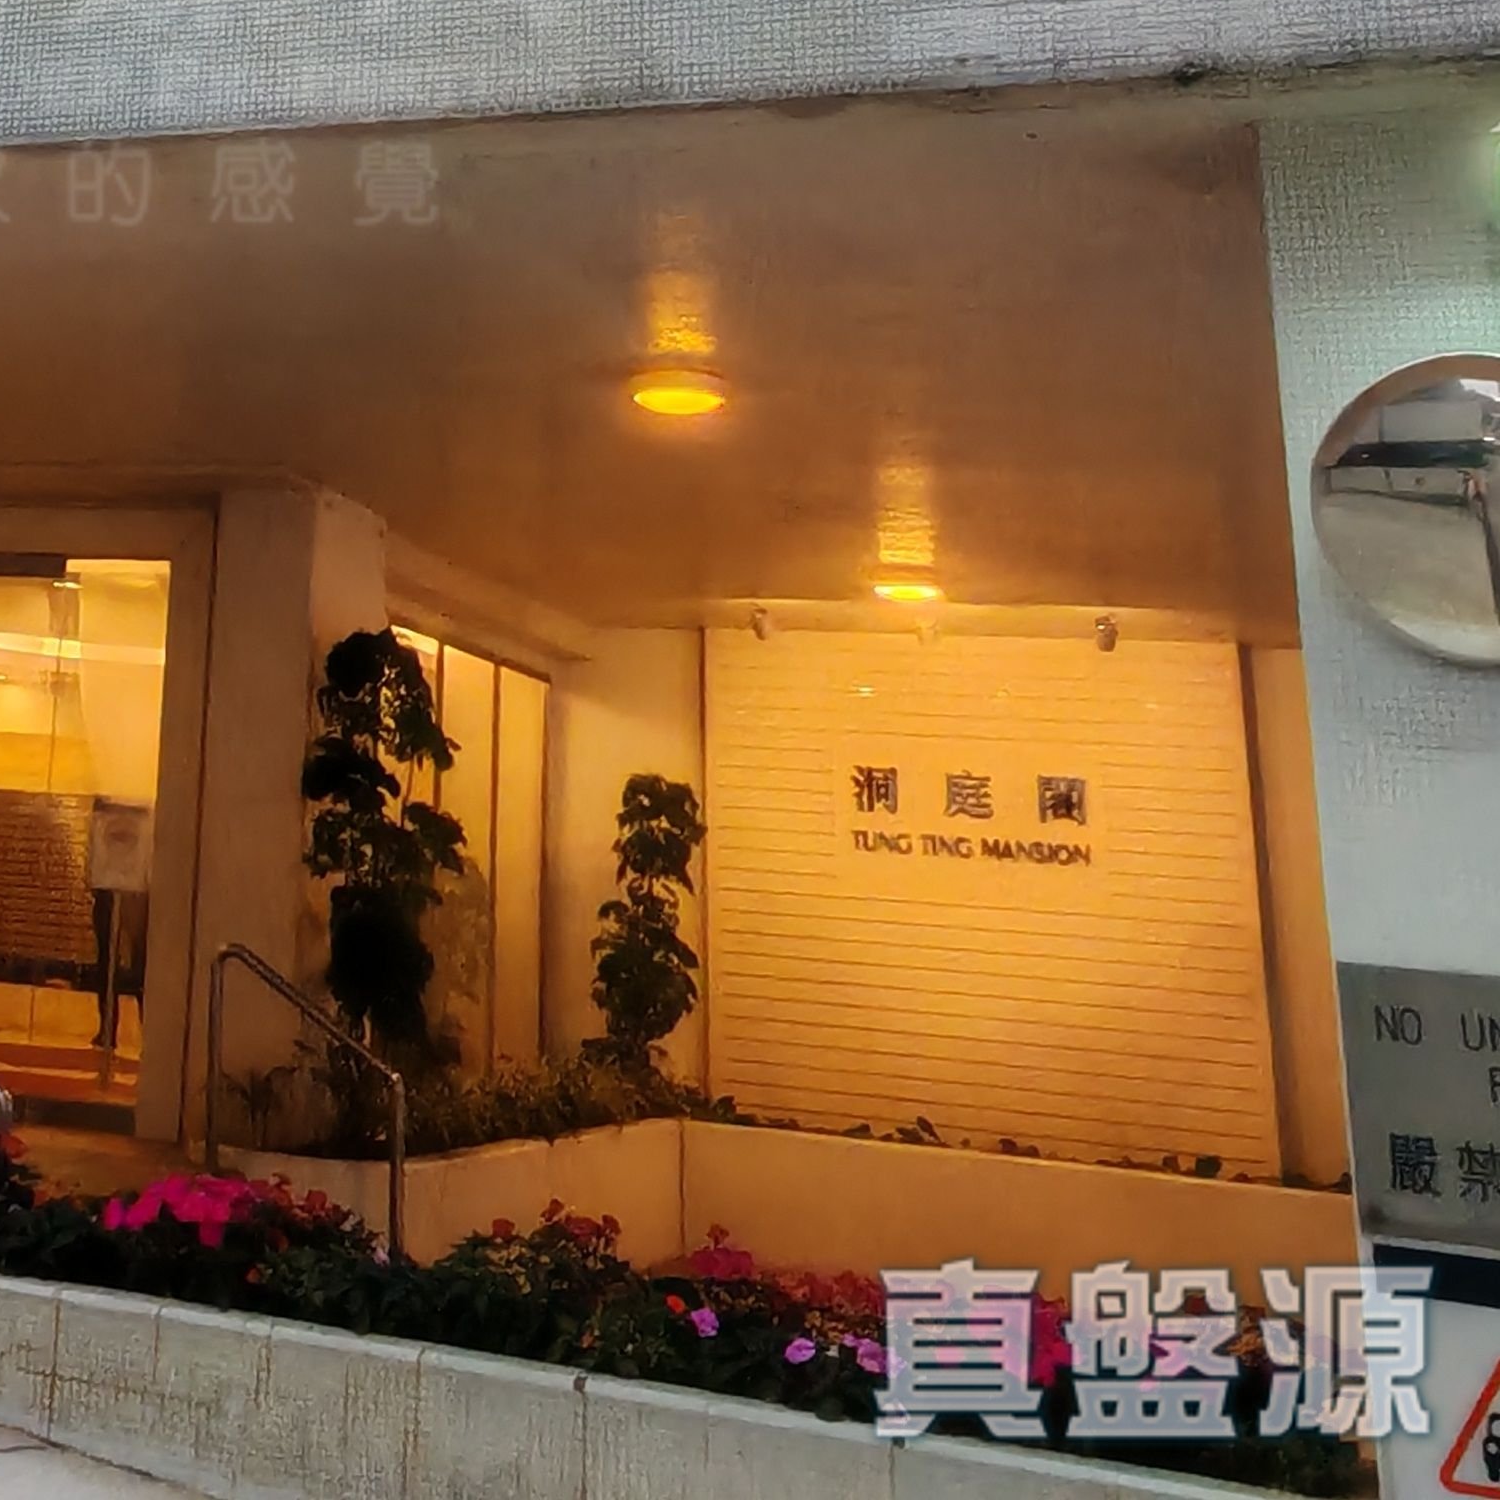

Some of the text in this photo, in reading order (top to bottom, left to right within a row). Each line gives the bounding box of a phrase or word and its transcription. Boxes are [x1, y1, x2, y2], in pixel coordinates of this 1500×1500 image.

[851, 829, 1092, 867] TUNG TING MANSION
[1374, 1004, 1422, 1045] NO
